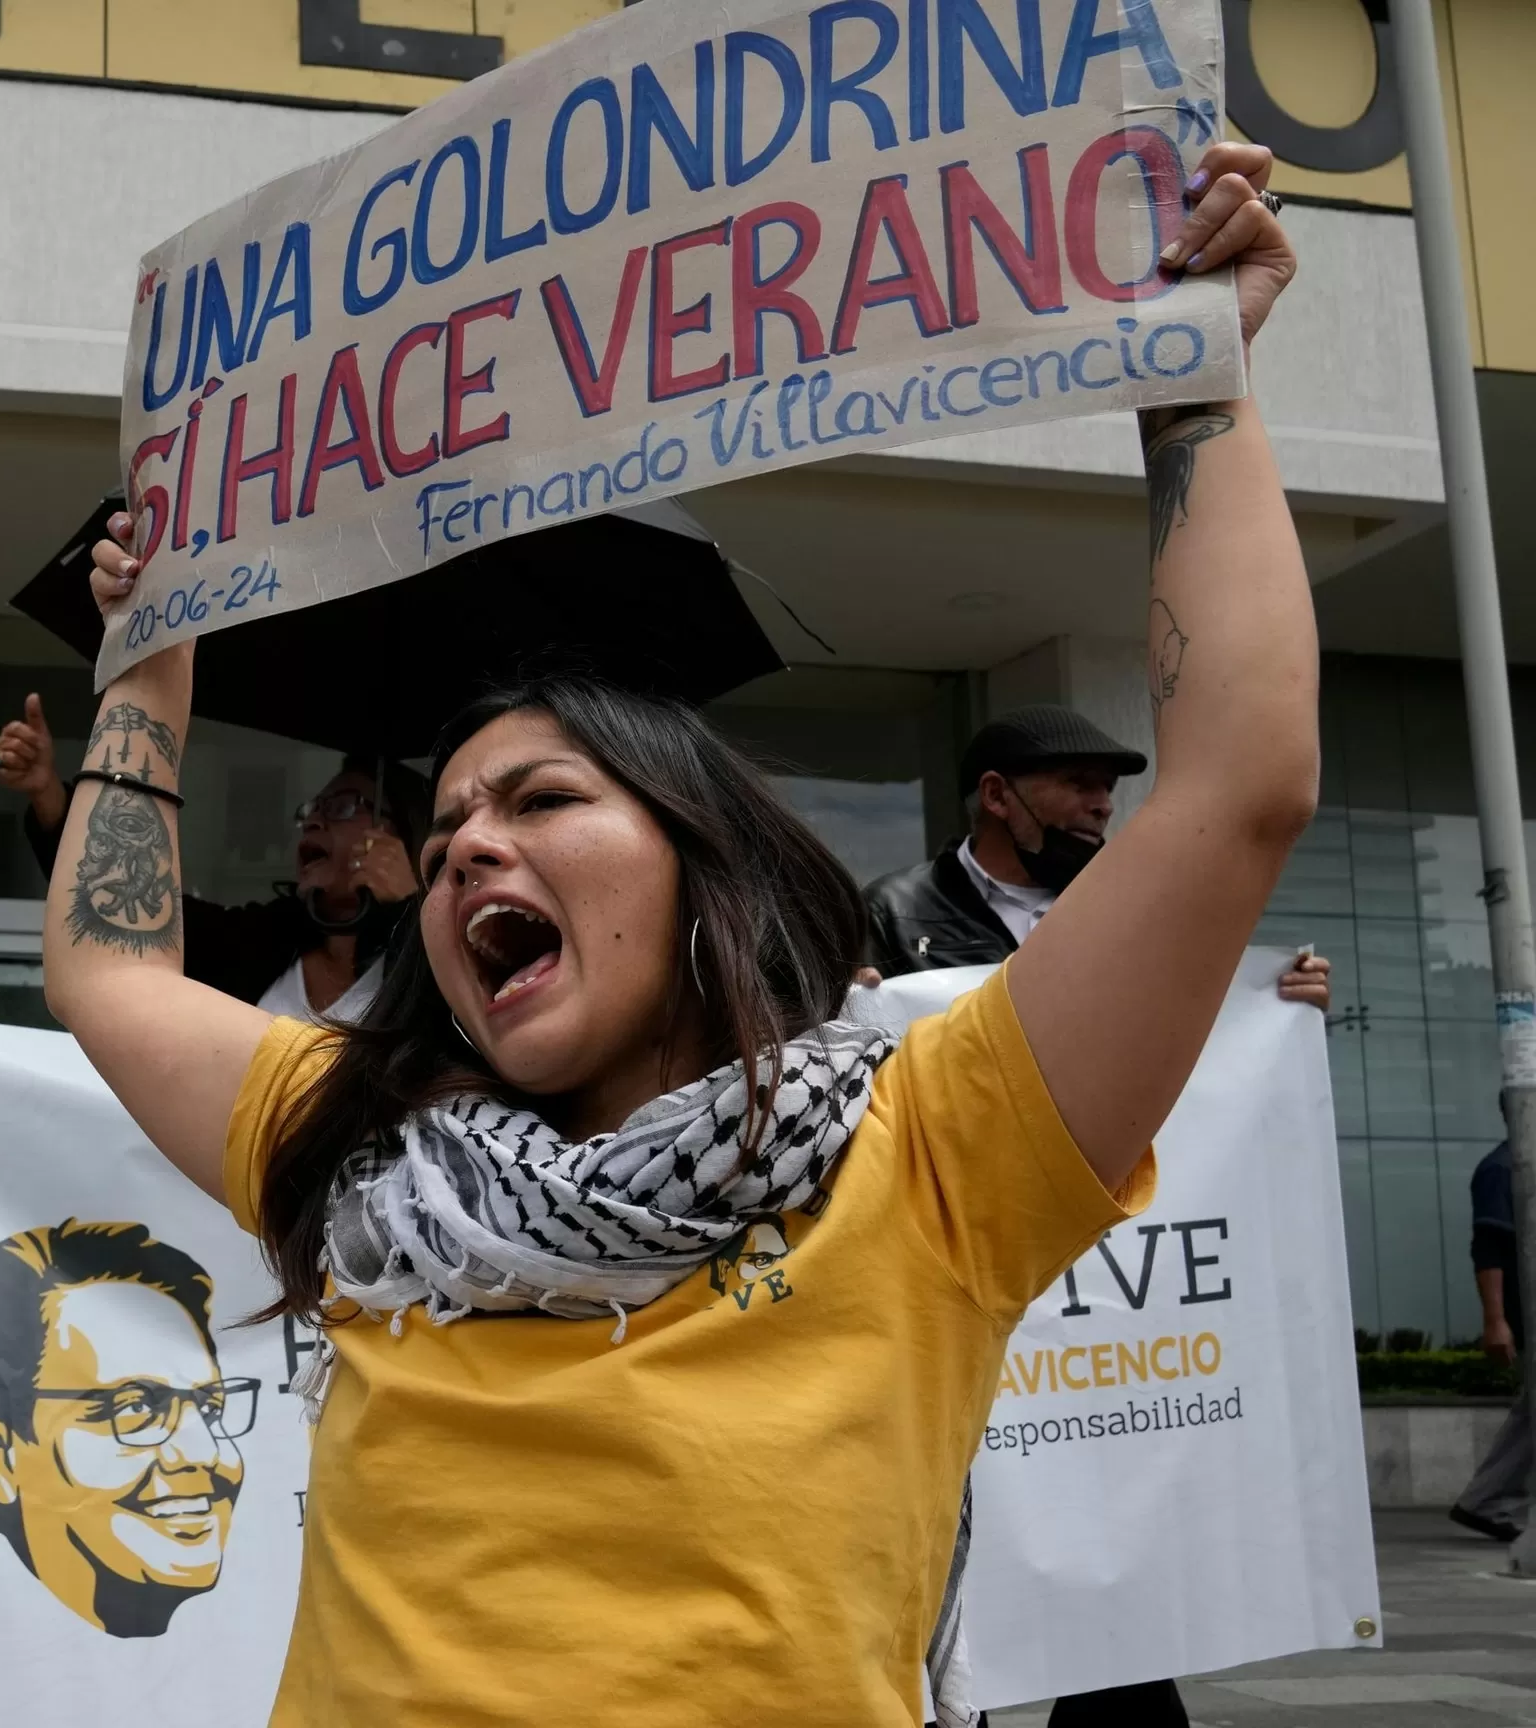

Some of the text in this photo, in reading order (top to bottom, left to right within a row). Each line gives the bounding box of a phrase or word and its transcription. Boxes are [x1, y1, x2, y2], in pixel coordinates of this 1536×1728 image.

[342, 0, 1183, 317] GOLONDRINA
[216, 288, 522, 544] HACE
[416, 317, 1206, 555] Fernando Villavicencio
[125, 559, 282, 650] 20-06-24
[731, 1268, 794, 1311] VE
[1061, 1217, 1232, 1318] IVE
[994, 1332, 1222, 1399] AVICENCIO
[977, 1386, 1244, 1457] esponsabilidad
